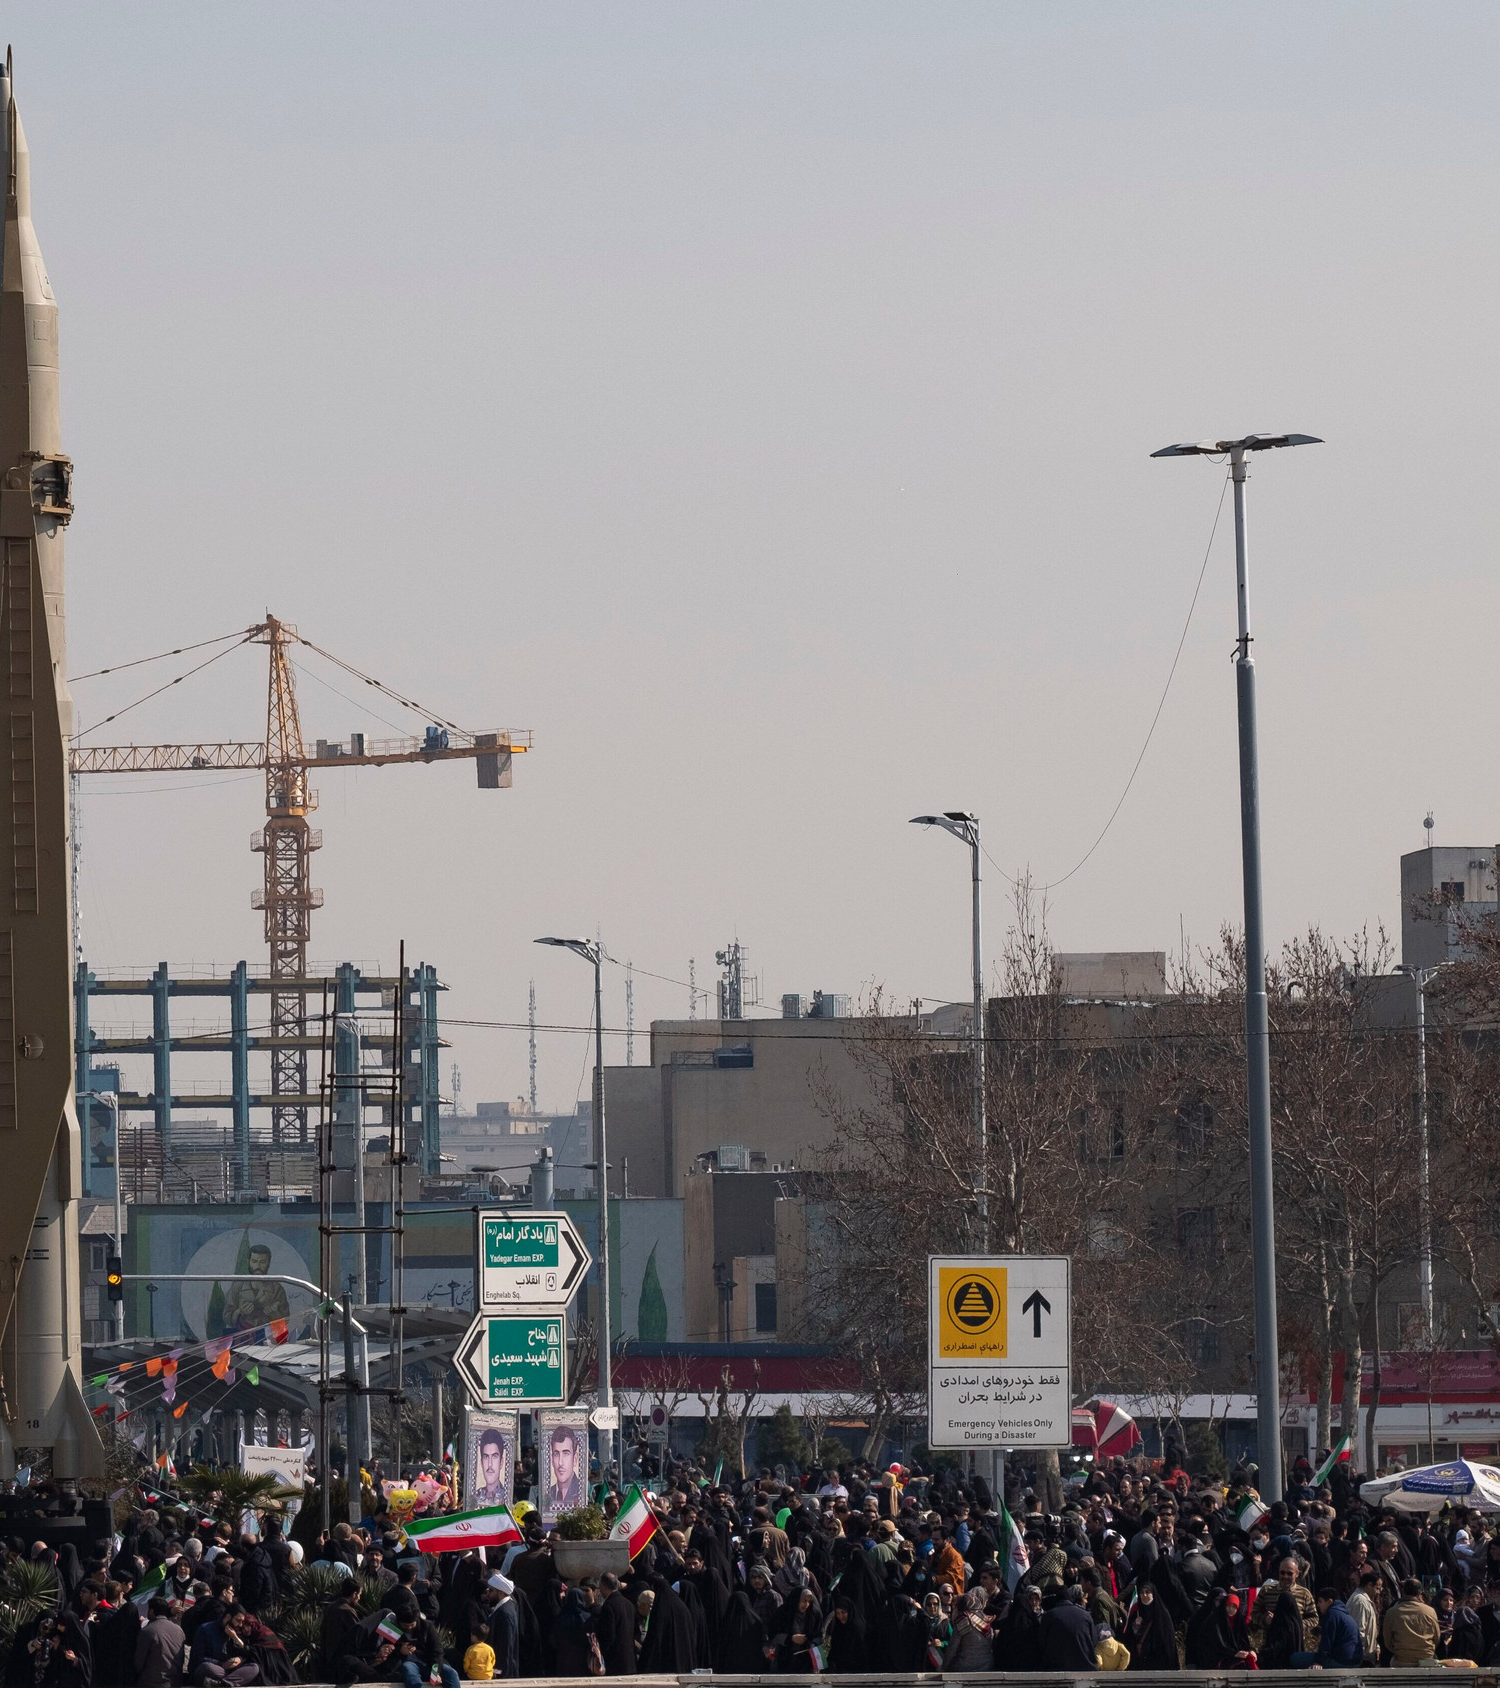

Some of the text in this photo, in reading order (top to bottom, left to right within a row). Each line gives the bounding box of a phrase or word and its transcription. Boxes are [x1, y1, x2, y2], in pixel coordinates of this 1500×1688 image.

[495, 1226, 514, 1247] امام
[489, 1253, 545, 1264] Yadegar Emam EXP.
[515, 1274, 541, 1288] انقلاب
[486, 1291, 522, 1300] Enghelab Sq.
[527, 1328, 547, 1346] جناح
[943, 1342, 977, 1352] اضطراری
[491, 1351, 547, 1367] شهید سعیدی
[493, 1376, 524, 1386] Jenah EXP.
[940, 1375, 1061, 1389] فقط خودروهای امدادی
[511, 1387, 524, 1396] EXP.
[958, 1391, 1043, 1405] در شرایط بحران
[25, 1419, 40, 1429] 18
[948, 1418, 1053, 1430] Emergency Vehicles Only
[964, 1430, 1037, 1441] During a Disaster
